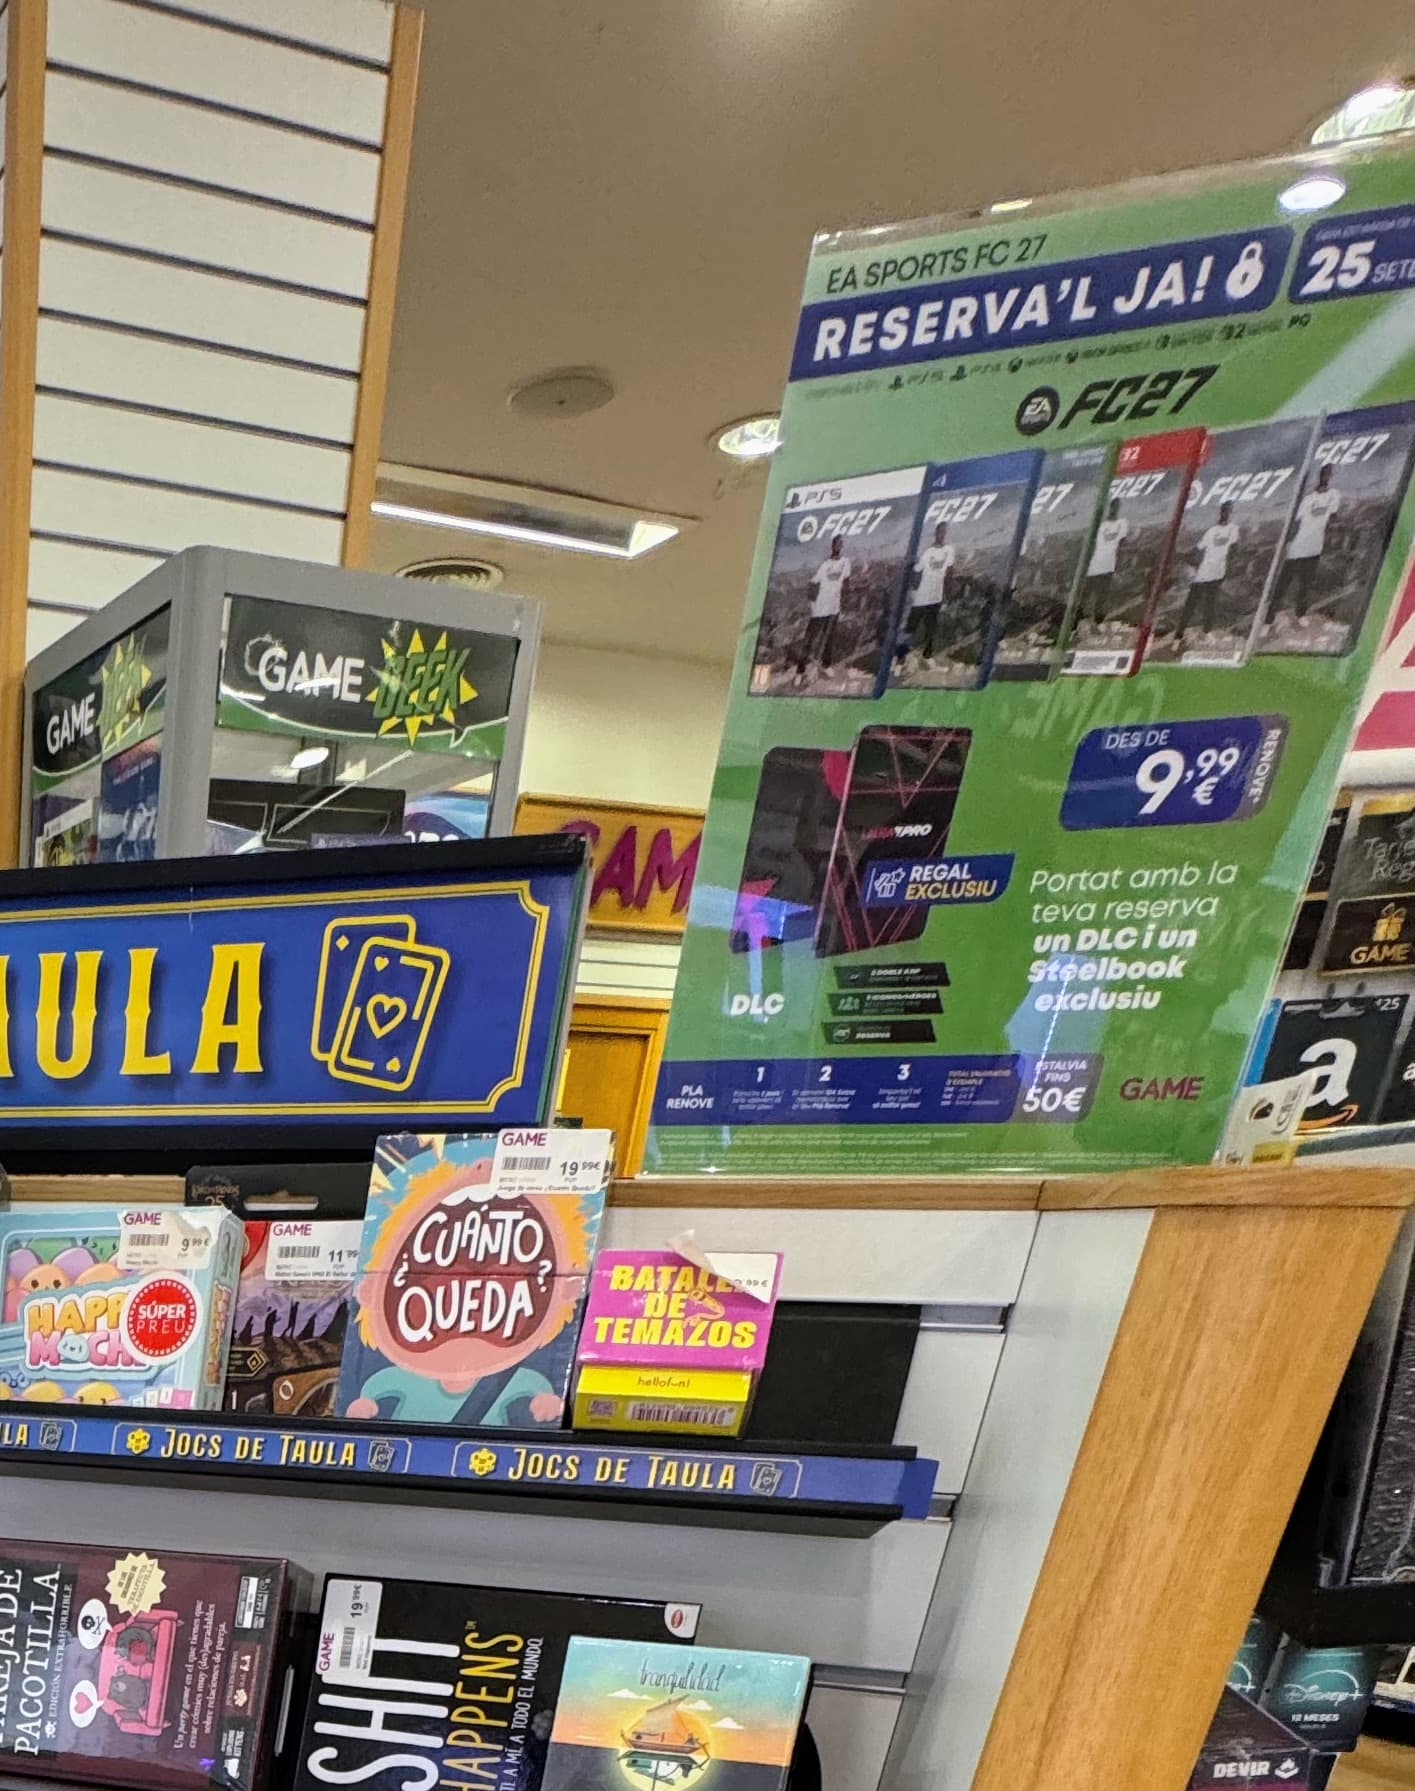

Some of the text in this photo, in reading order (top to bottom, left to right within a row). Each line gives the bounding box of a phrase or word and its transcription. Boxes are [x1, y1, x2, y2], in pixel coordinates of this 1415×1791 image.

[827, 234, 1047, 294] EA SPORTS FC 27
[1300, 241, 1376, 295] 25
[1114, 256, 1205, 314] JA!
[1058, 365, 1220, 428] FC27
[258, 648, 365, 704] GAME
[46, 693, 95, 755] GAME
[1106, 729, 1171, 749] DES DE
[909, 863, 971, 882] REGAL
[1030, 860, 1239, 893] Portat amb la
[905, 880, 998, 900] EXCLUSIU
[1032, 895, 1219, 924] teva reserva
[1033, 924, 1198, 953] un DLC i un
[1028, 954, 1187, 983] Steelbook
[730, 993, 785, 1017] DLC
[1034, 987, 1162, 1012] exclusiu
[818, 1066, 833, 1082] 2
[897, 1064, 911, 1080] 3
[681, 1085, 703, 1096] PLA
[1023, 1088, 1086, 1113] 50€
[1120, 1077, 1203, 1101] GAME
[666, 1097, 714, 1110] RENOVE
[559, 1160, 578, 1177] 19
[137, 1302, 186, 1320] SÚPER
[644, 1291, 689, 1319] DE
[594, 1317, 757, 1349] TEMAZOS
[509, 1448, 736, 1491] JOCS DE TAULA
[15, 1569, 61, 1756] PACOTILLA
[1213, 1761, 1270, 1780] DEVIR
